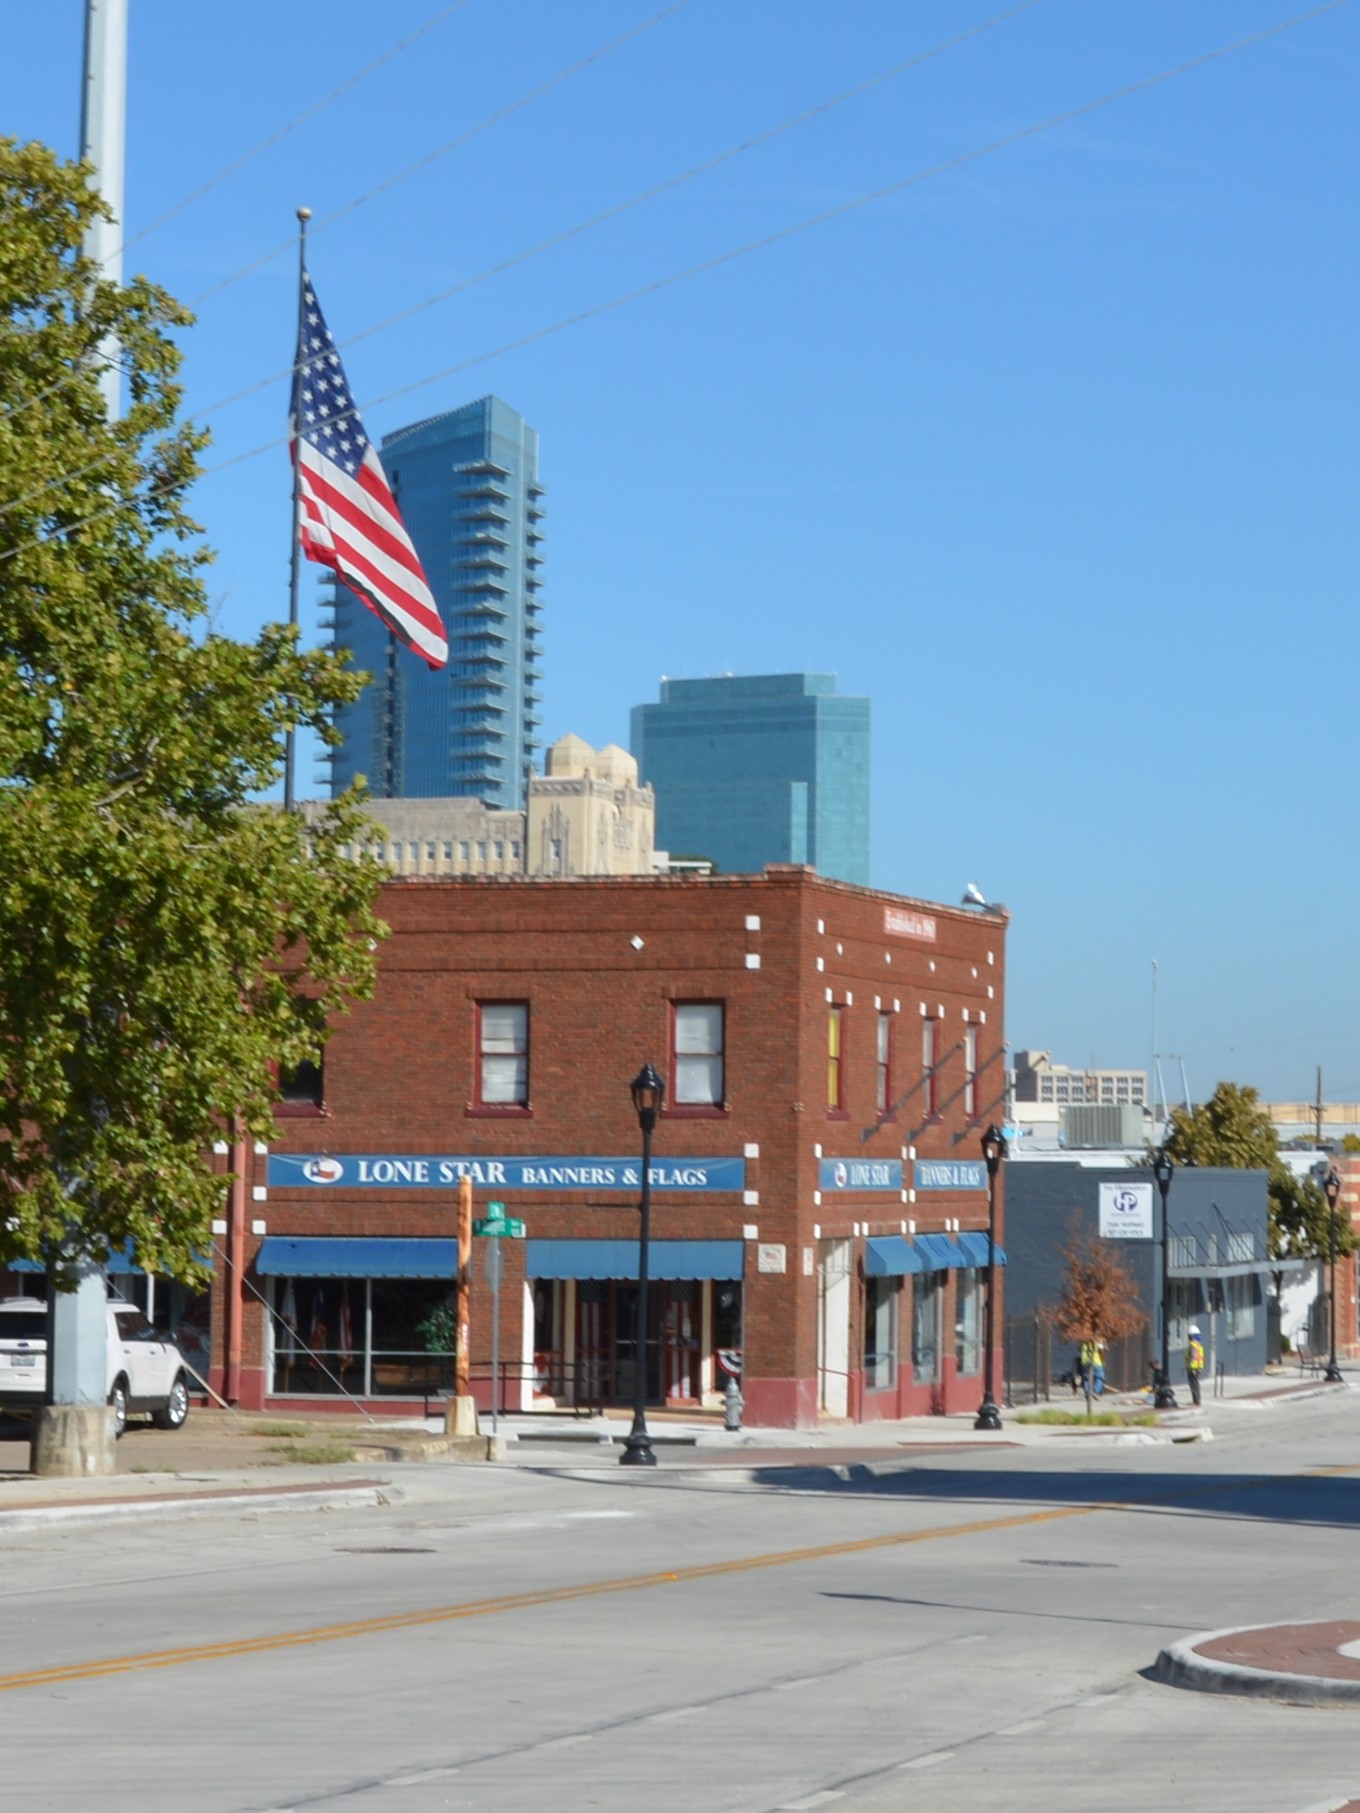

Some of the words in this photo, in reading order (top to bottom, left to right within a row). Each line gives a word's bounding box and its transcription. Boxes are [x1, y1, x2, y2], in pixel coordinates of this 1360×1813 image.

[358, 1160, 429, 1182] LONE
[439, 1161, 507, 1183] STAR
[521, 1167, 615, 1184] BANNERS
[622, 1168, 638, 1185] &
[648, 1168, 707, 1185] FLAGS
[851, 1165, 870, 1186] LONE
[871, 1165, 890, 1186] STAR
